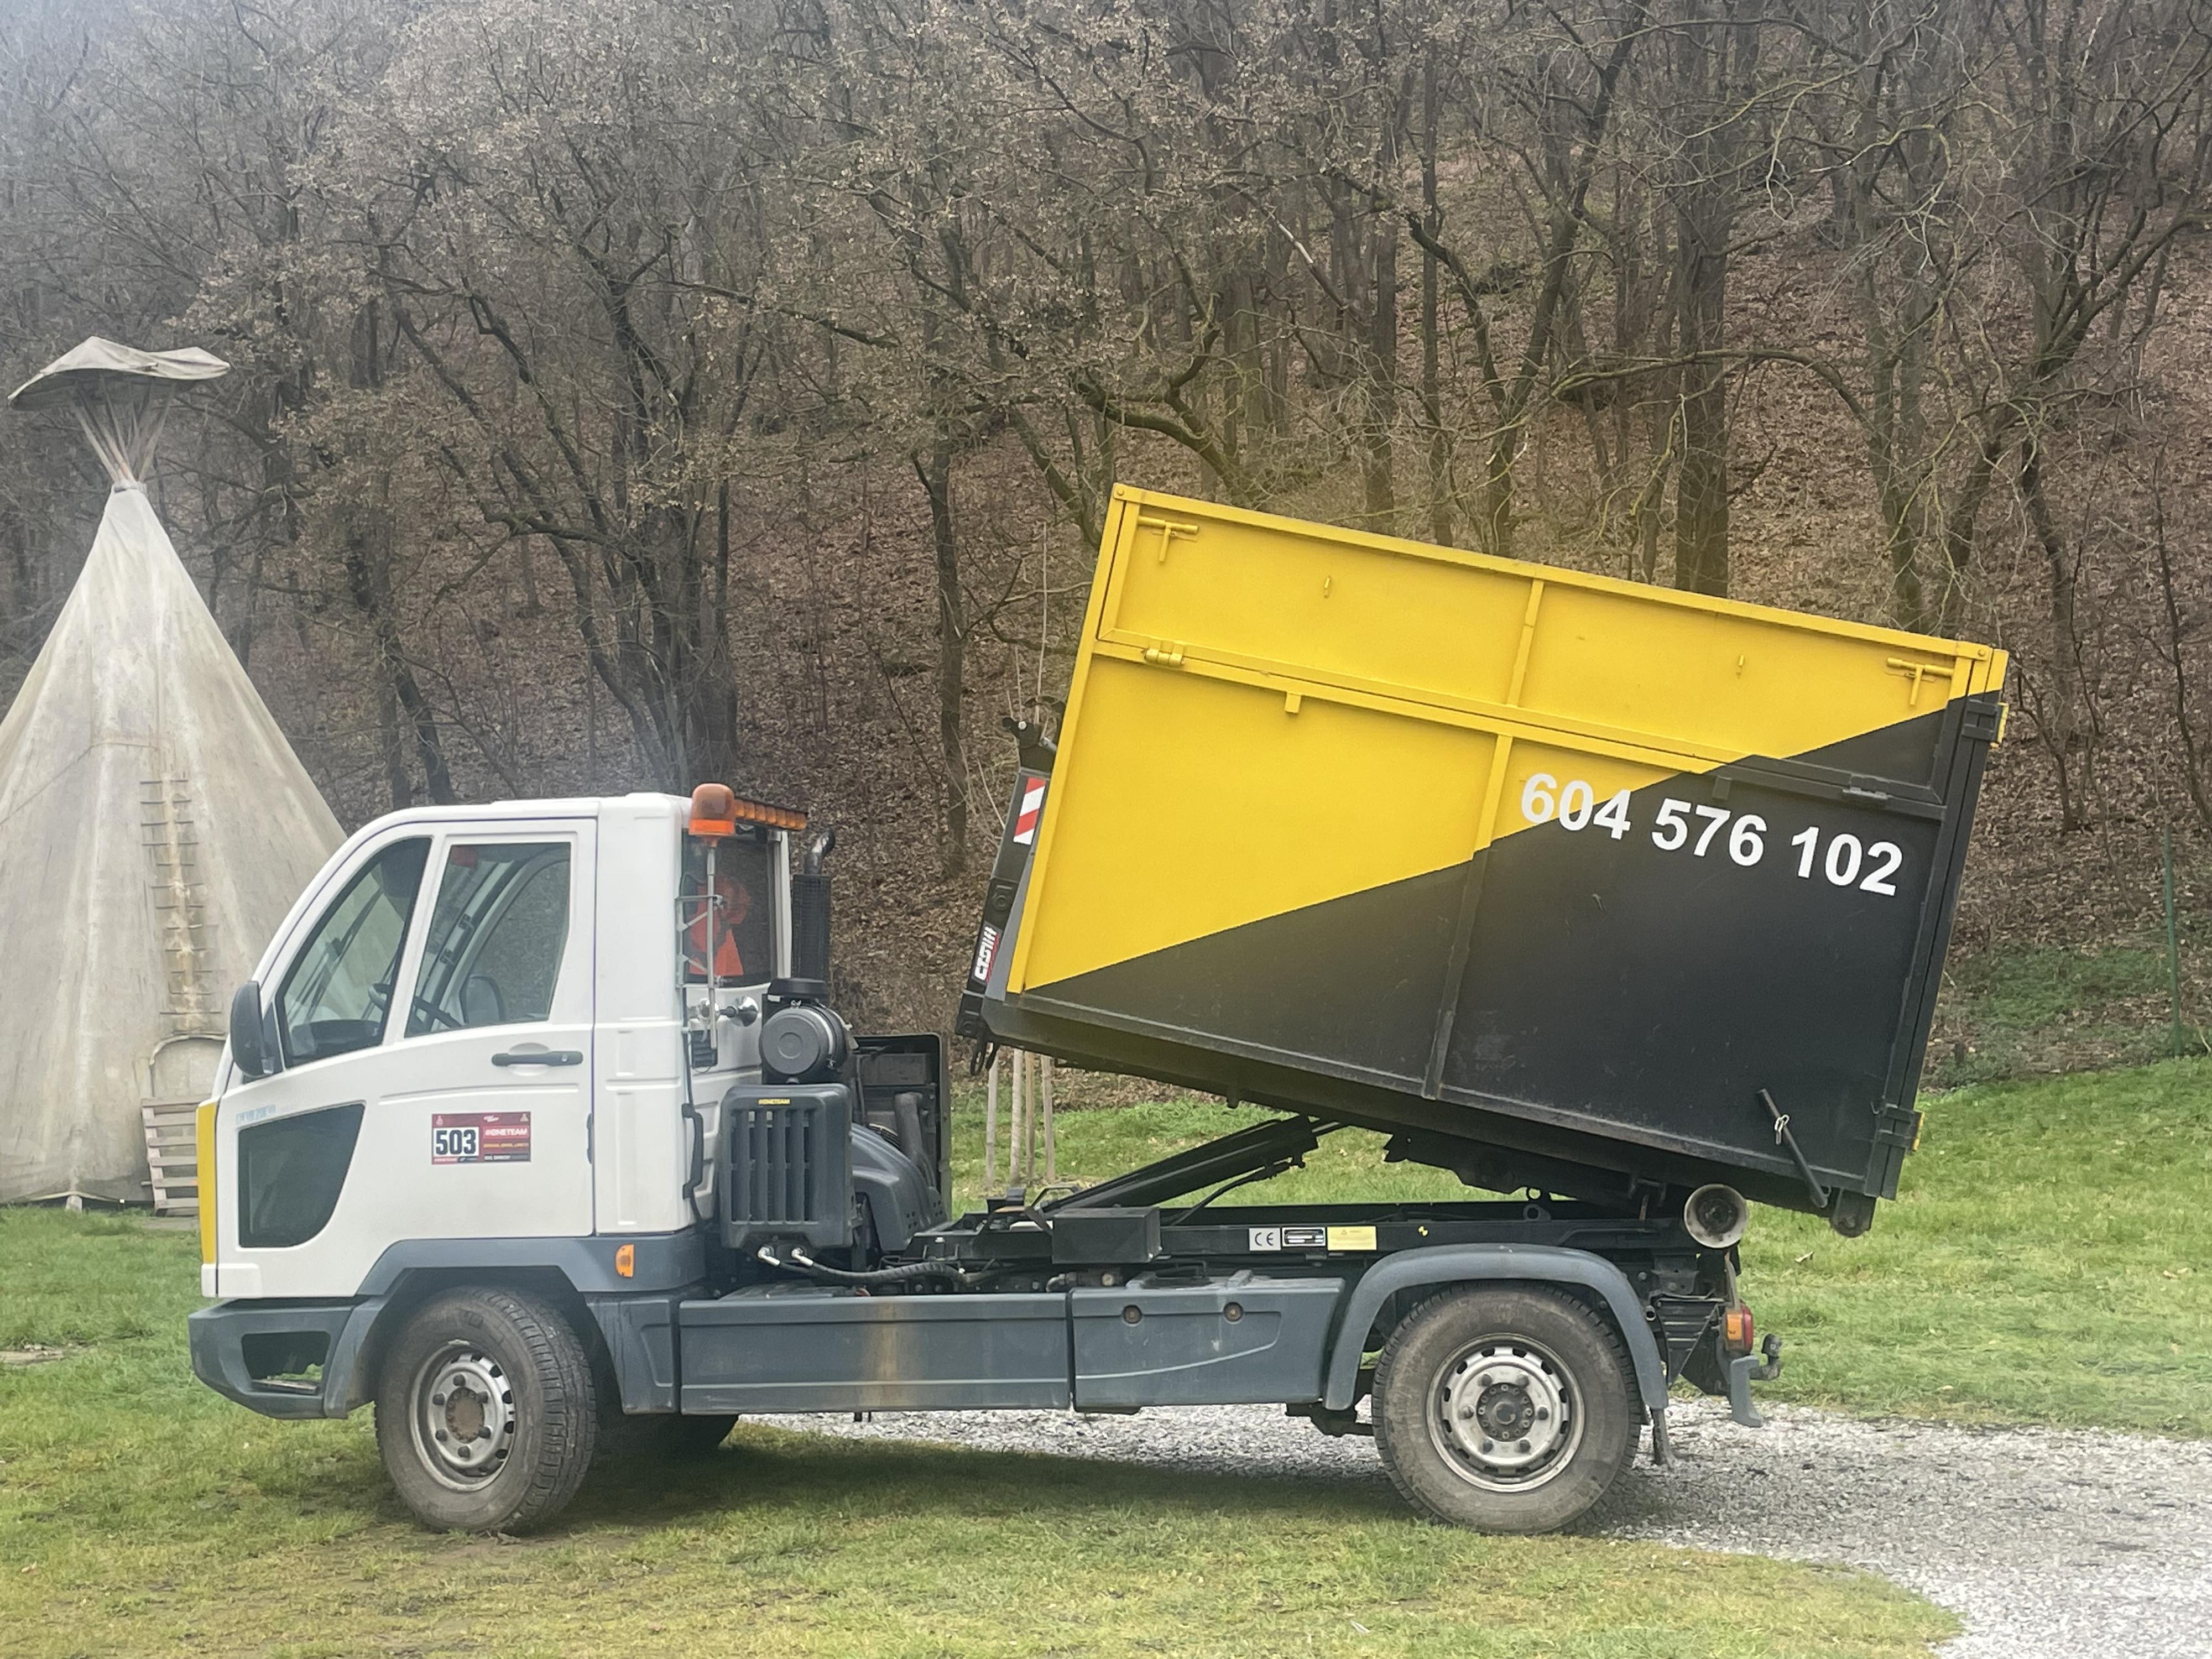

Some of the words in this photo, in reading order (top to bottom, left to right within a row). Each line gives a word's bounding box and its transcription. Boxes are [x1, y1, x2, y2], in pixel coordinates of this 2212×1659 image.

[1521, 773, 1631, 840] 604
[1651, 798, 1767, 867] 576
[1791, 826, 1903, 896] 102
[436, 1129, 476, 1155] 503
[1254, 1232, 1274, 1247] CE
